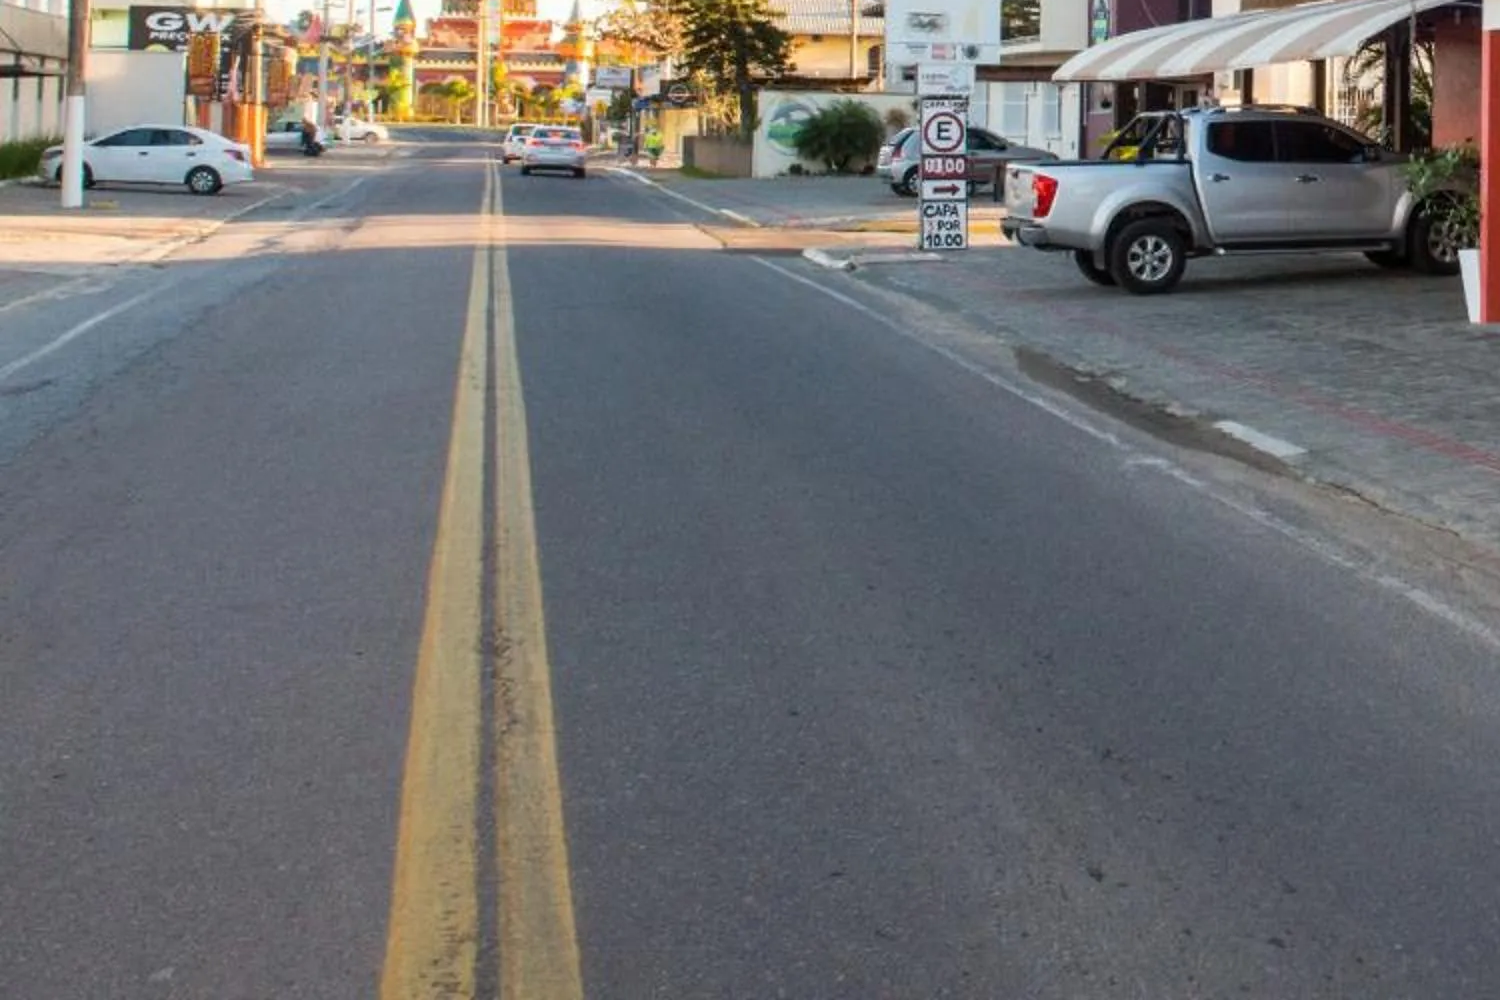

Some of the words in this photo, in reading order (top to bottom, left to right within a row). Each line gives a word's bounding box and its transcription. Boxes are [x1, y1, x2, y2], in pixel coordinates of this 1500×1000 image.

[145, 11, 236, 33] GW
[937, 121, 953, 140] E
[924, 203, 959, 218] CAPA
[937, 219, 961, 232] POR
